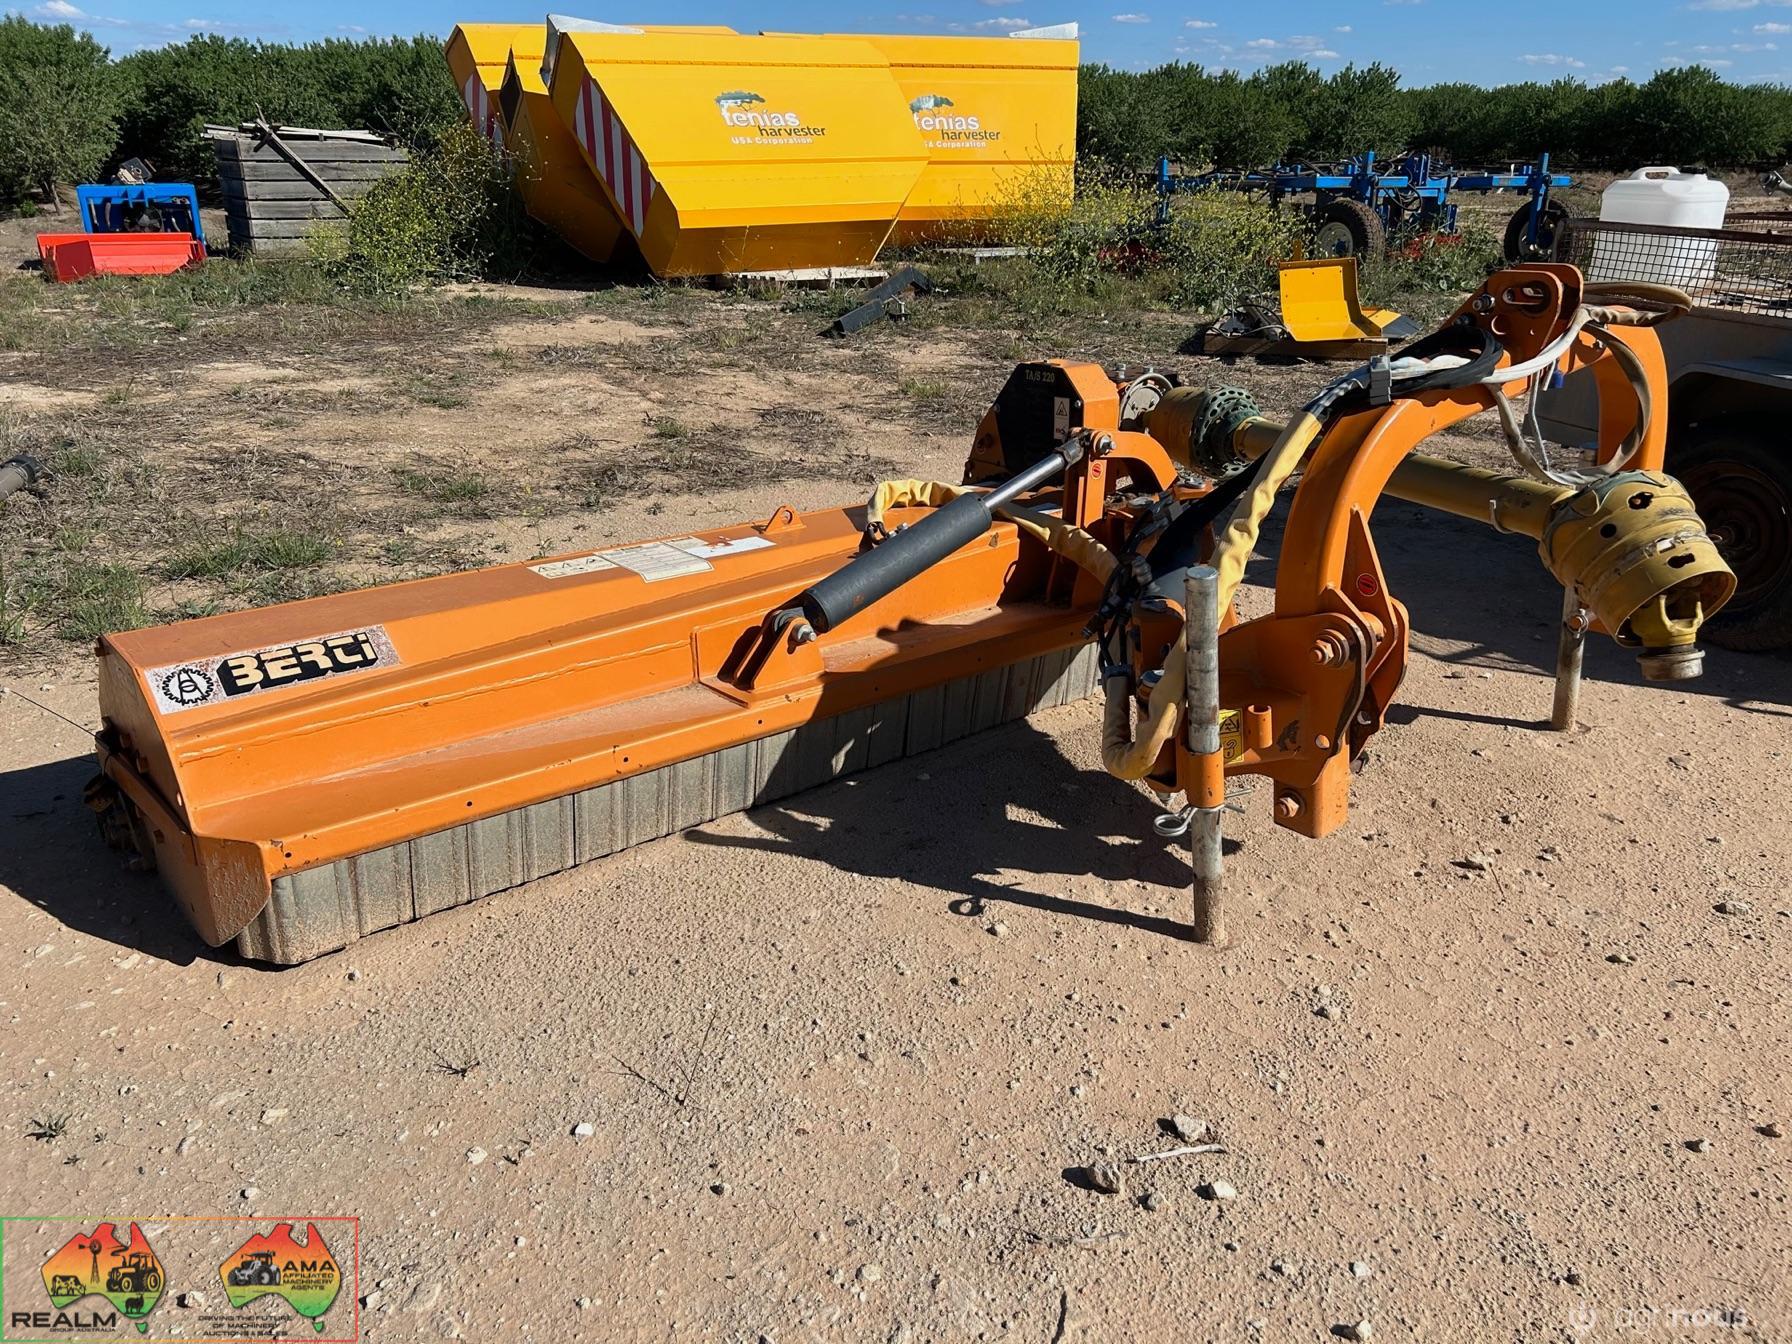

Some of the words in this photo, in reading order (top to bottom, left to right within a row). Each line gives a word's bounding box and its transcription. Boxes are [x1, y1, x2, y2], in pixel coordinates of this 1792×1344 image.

[757, 124, 826, 137] harvester
[941, 128, 1001, 141] harvester
[754, 136, 813, 145] Corporation
[935, 140, 987, 148] Corporation
[1042, 371, 1055, 383] 220
